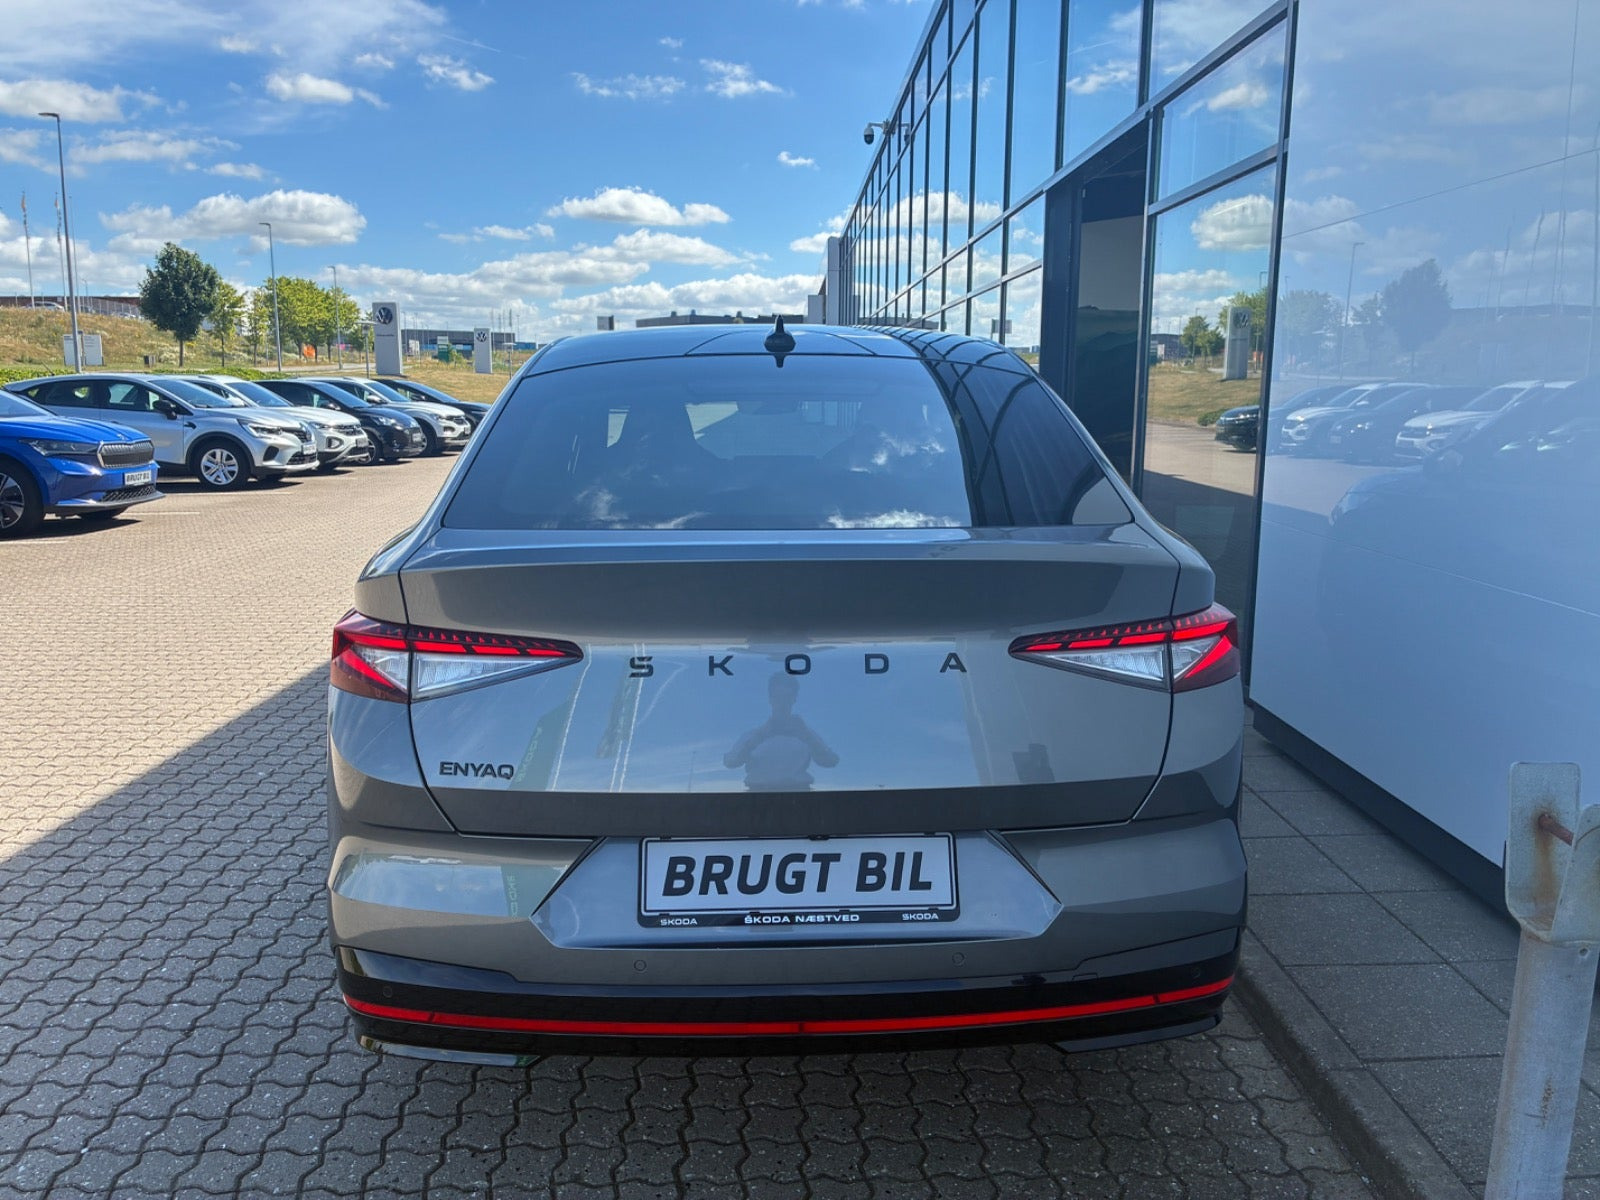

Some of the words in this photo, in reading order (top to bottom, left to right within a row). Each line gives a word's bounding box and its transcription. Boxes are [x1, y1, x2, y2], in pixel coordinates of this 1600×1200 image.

[439, 761, 514, 780] ENYAQ
[662, 852, 841, 897] BRUGT
[855, 851, 933, 893] BIL
[795, 914, 860, 923] NÆSTVED
